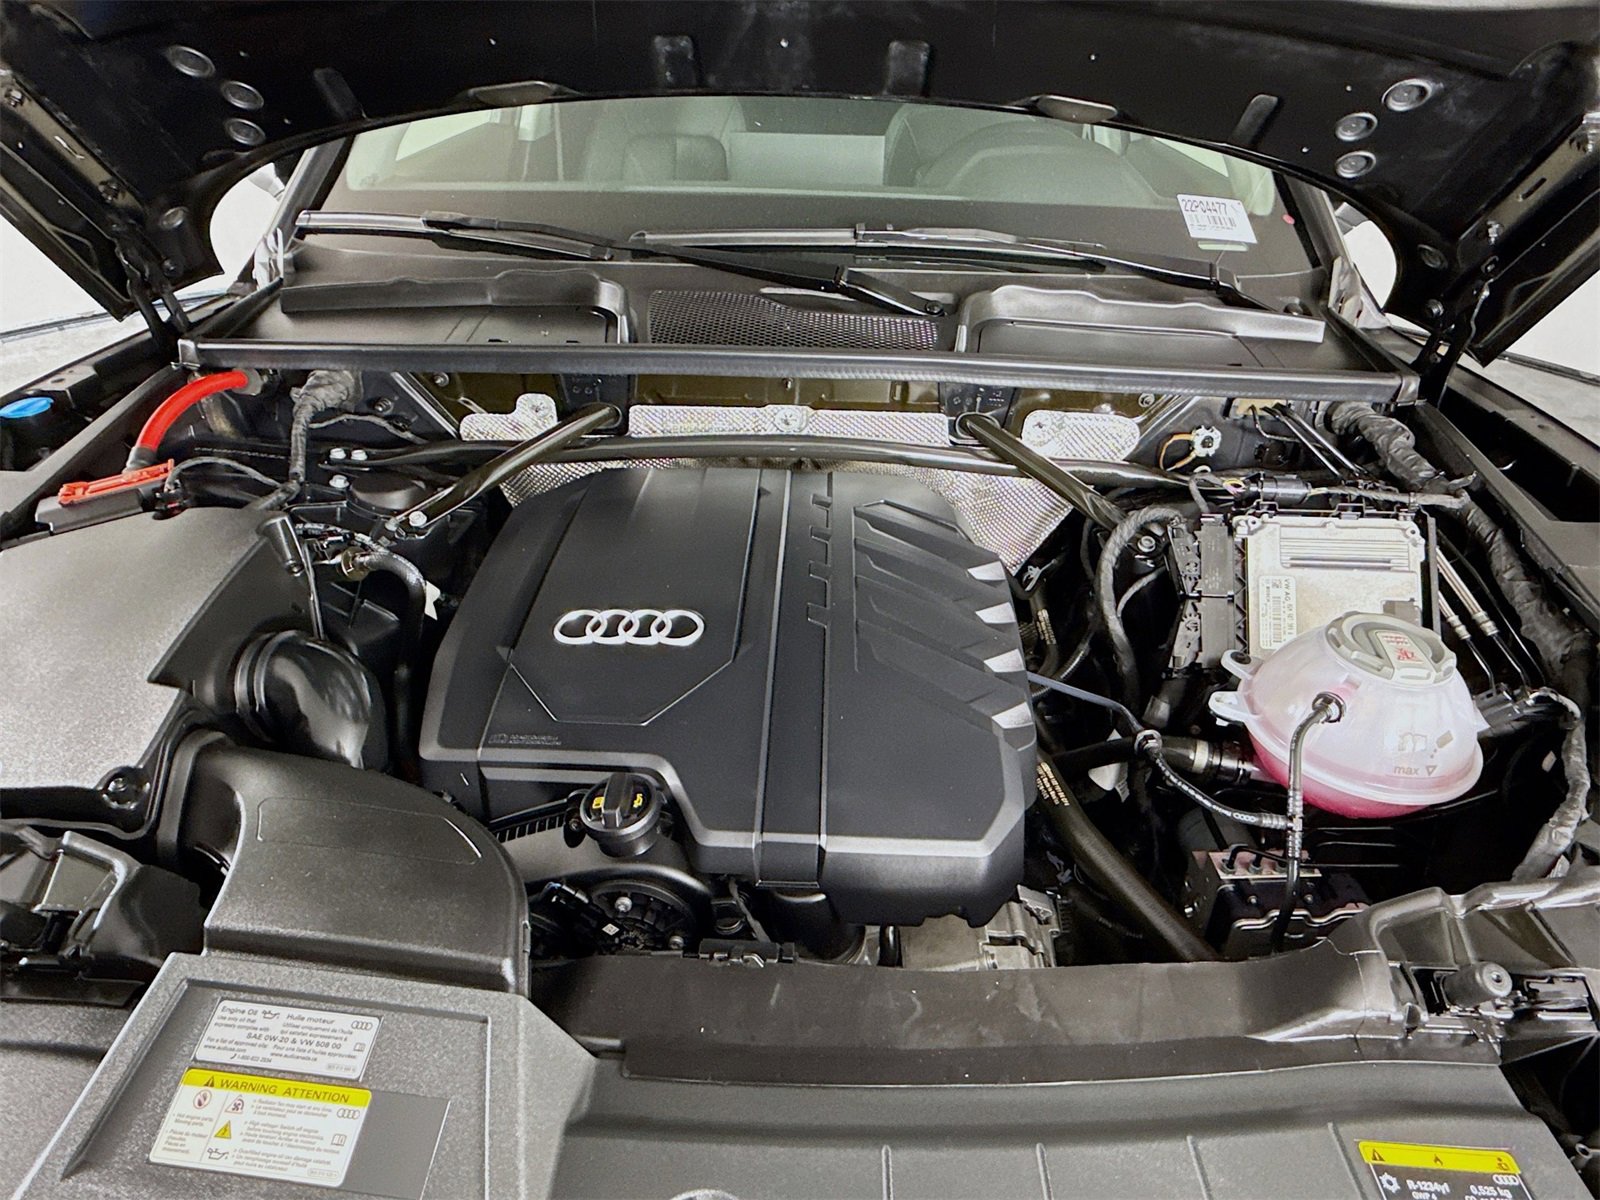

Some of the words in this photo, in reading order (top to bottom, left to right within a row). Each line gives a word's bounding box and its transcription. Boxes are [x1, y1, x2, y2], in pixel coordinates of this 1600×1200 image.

[1393, 766, 1419, 776] max
[221, 1006, 245, 1014] Engine
[306, 1016, 334, 1024] moteur
[246, 1032, 262, 1040] SAE
[263, 1034, 289, 1043] 0W-20
[299, 1038, 313, 1046] VW
[219, 1079, 277, 1094] WARNING
[283, 1087, 349, 1102] ATTENTION
[1496, 1187, 1513, 1199] kg
